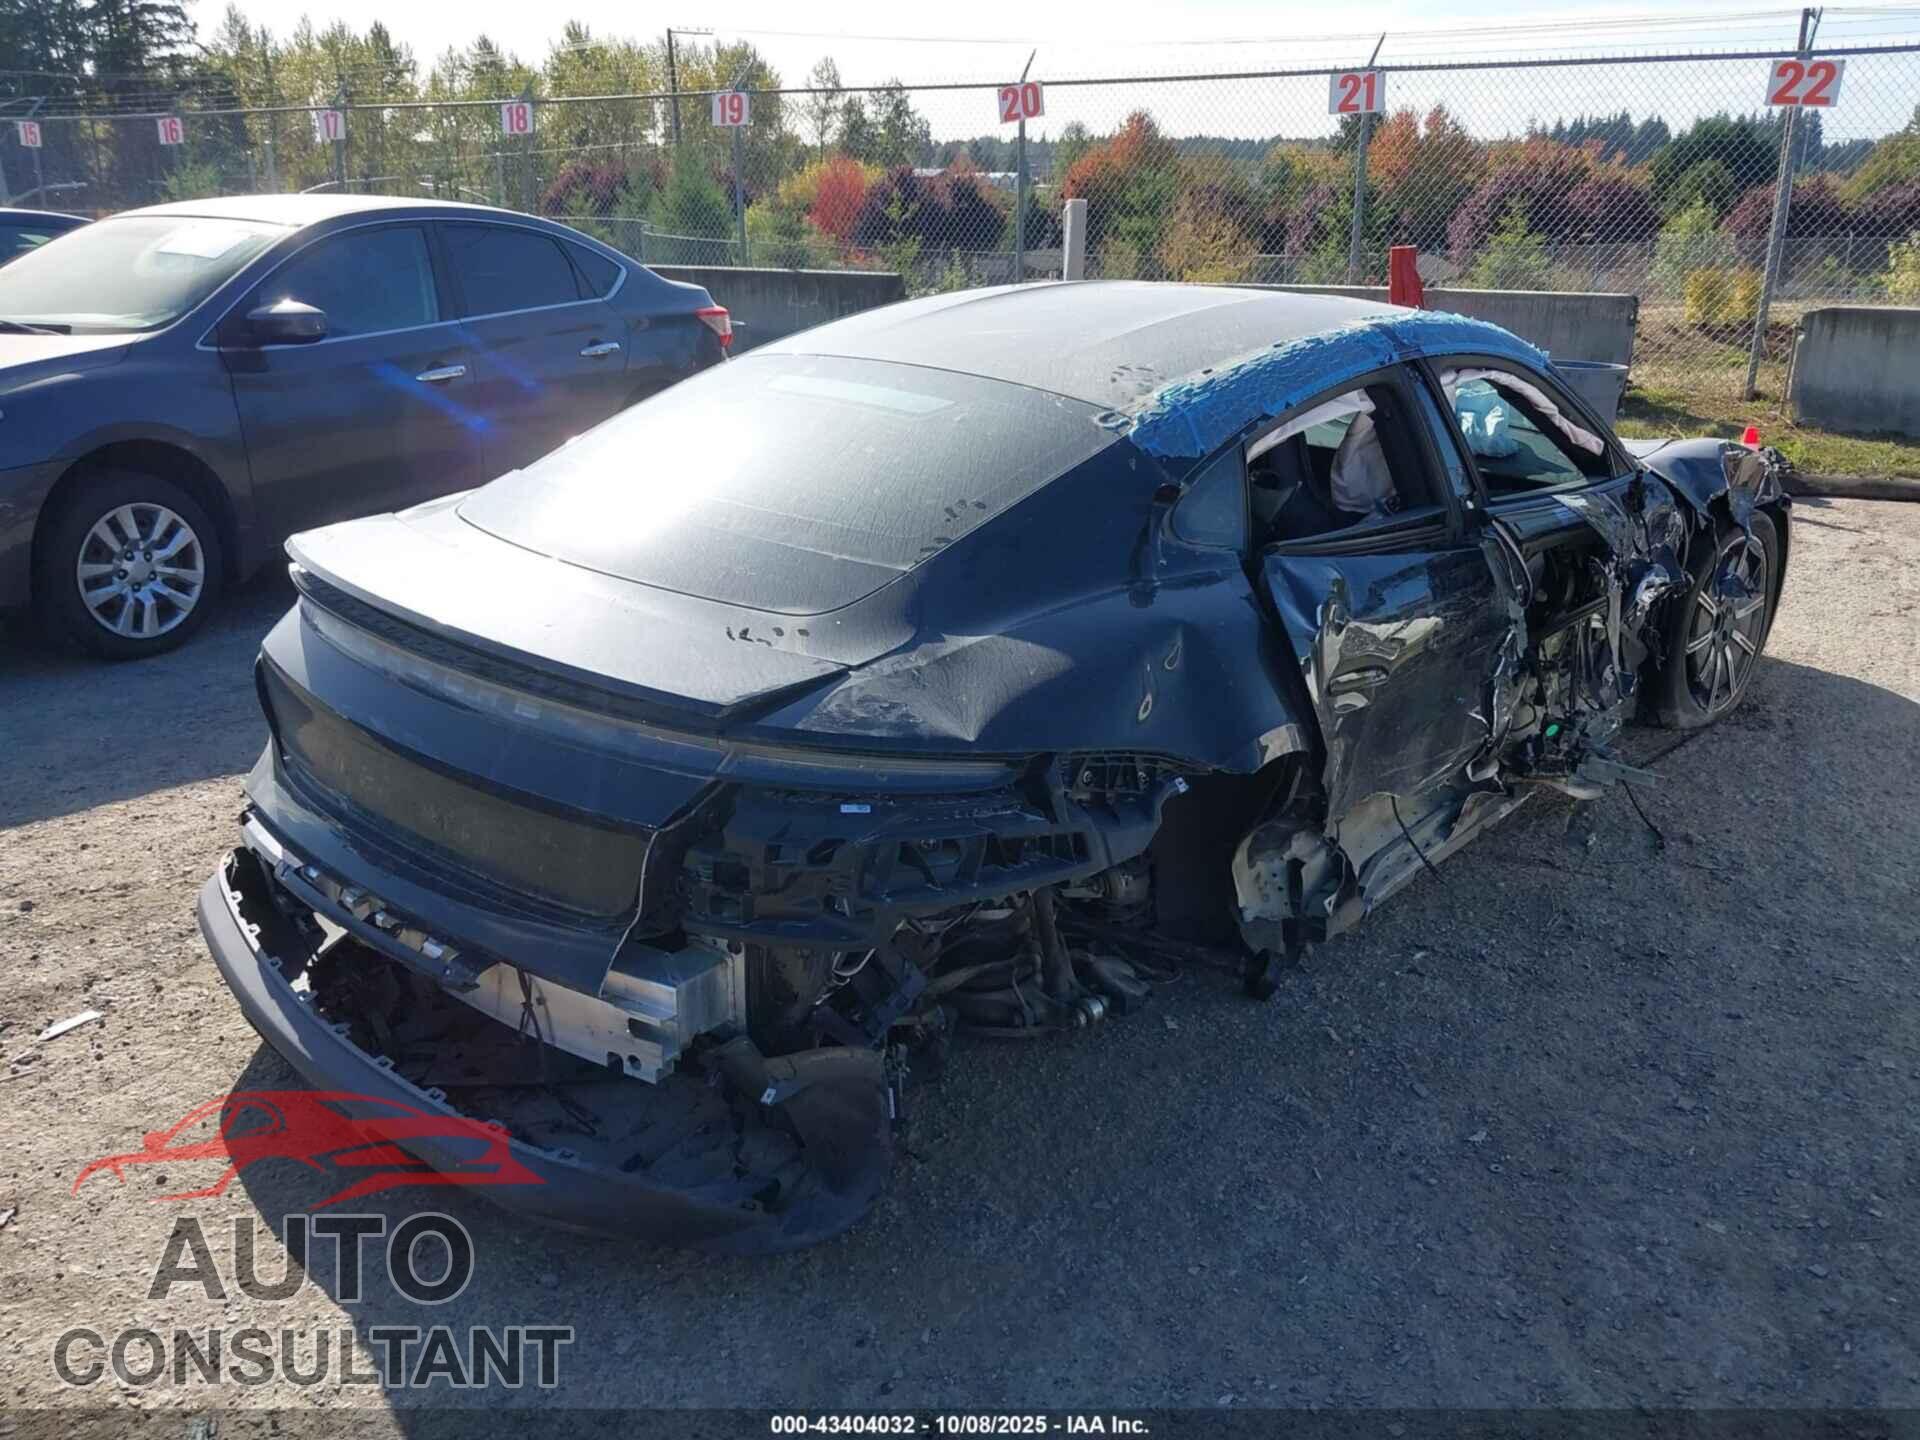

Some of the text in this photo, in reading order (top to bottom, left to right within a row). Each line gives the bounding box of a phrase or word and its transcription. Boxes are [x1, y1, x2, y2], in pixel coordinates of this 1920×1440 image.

[1338, 73, 1377, 112] 21
[1770, 61, 1838, 105] 22
[718, 94, 743, 124] 19
[1002, 83, 1041, 121] 20
[161, 119, 178, 143] 16
[323, 112, 339, 138] 17
[506, 105, 529, 133] 18
[23, 123, 38, 145] 15
